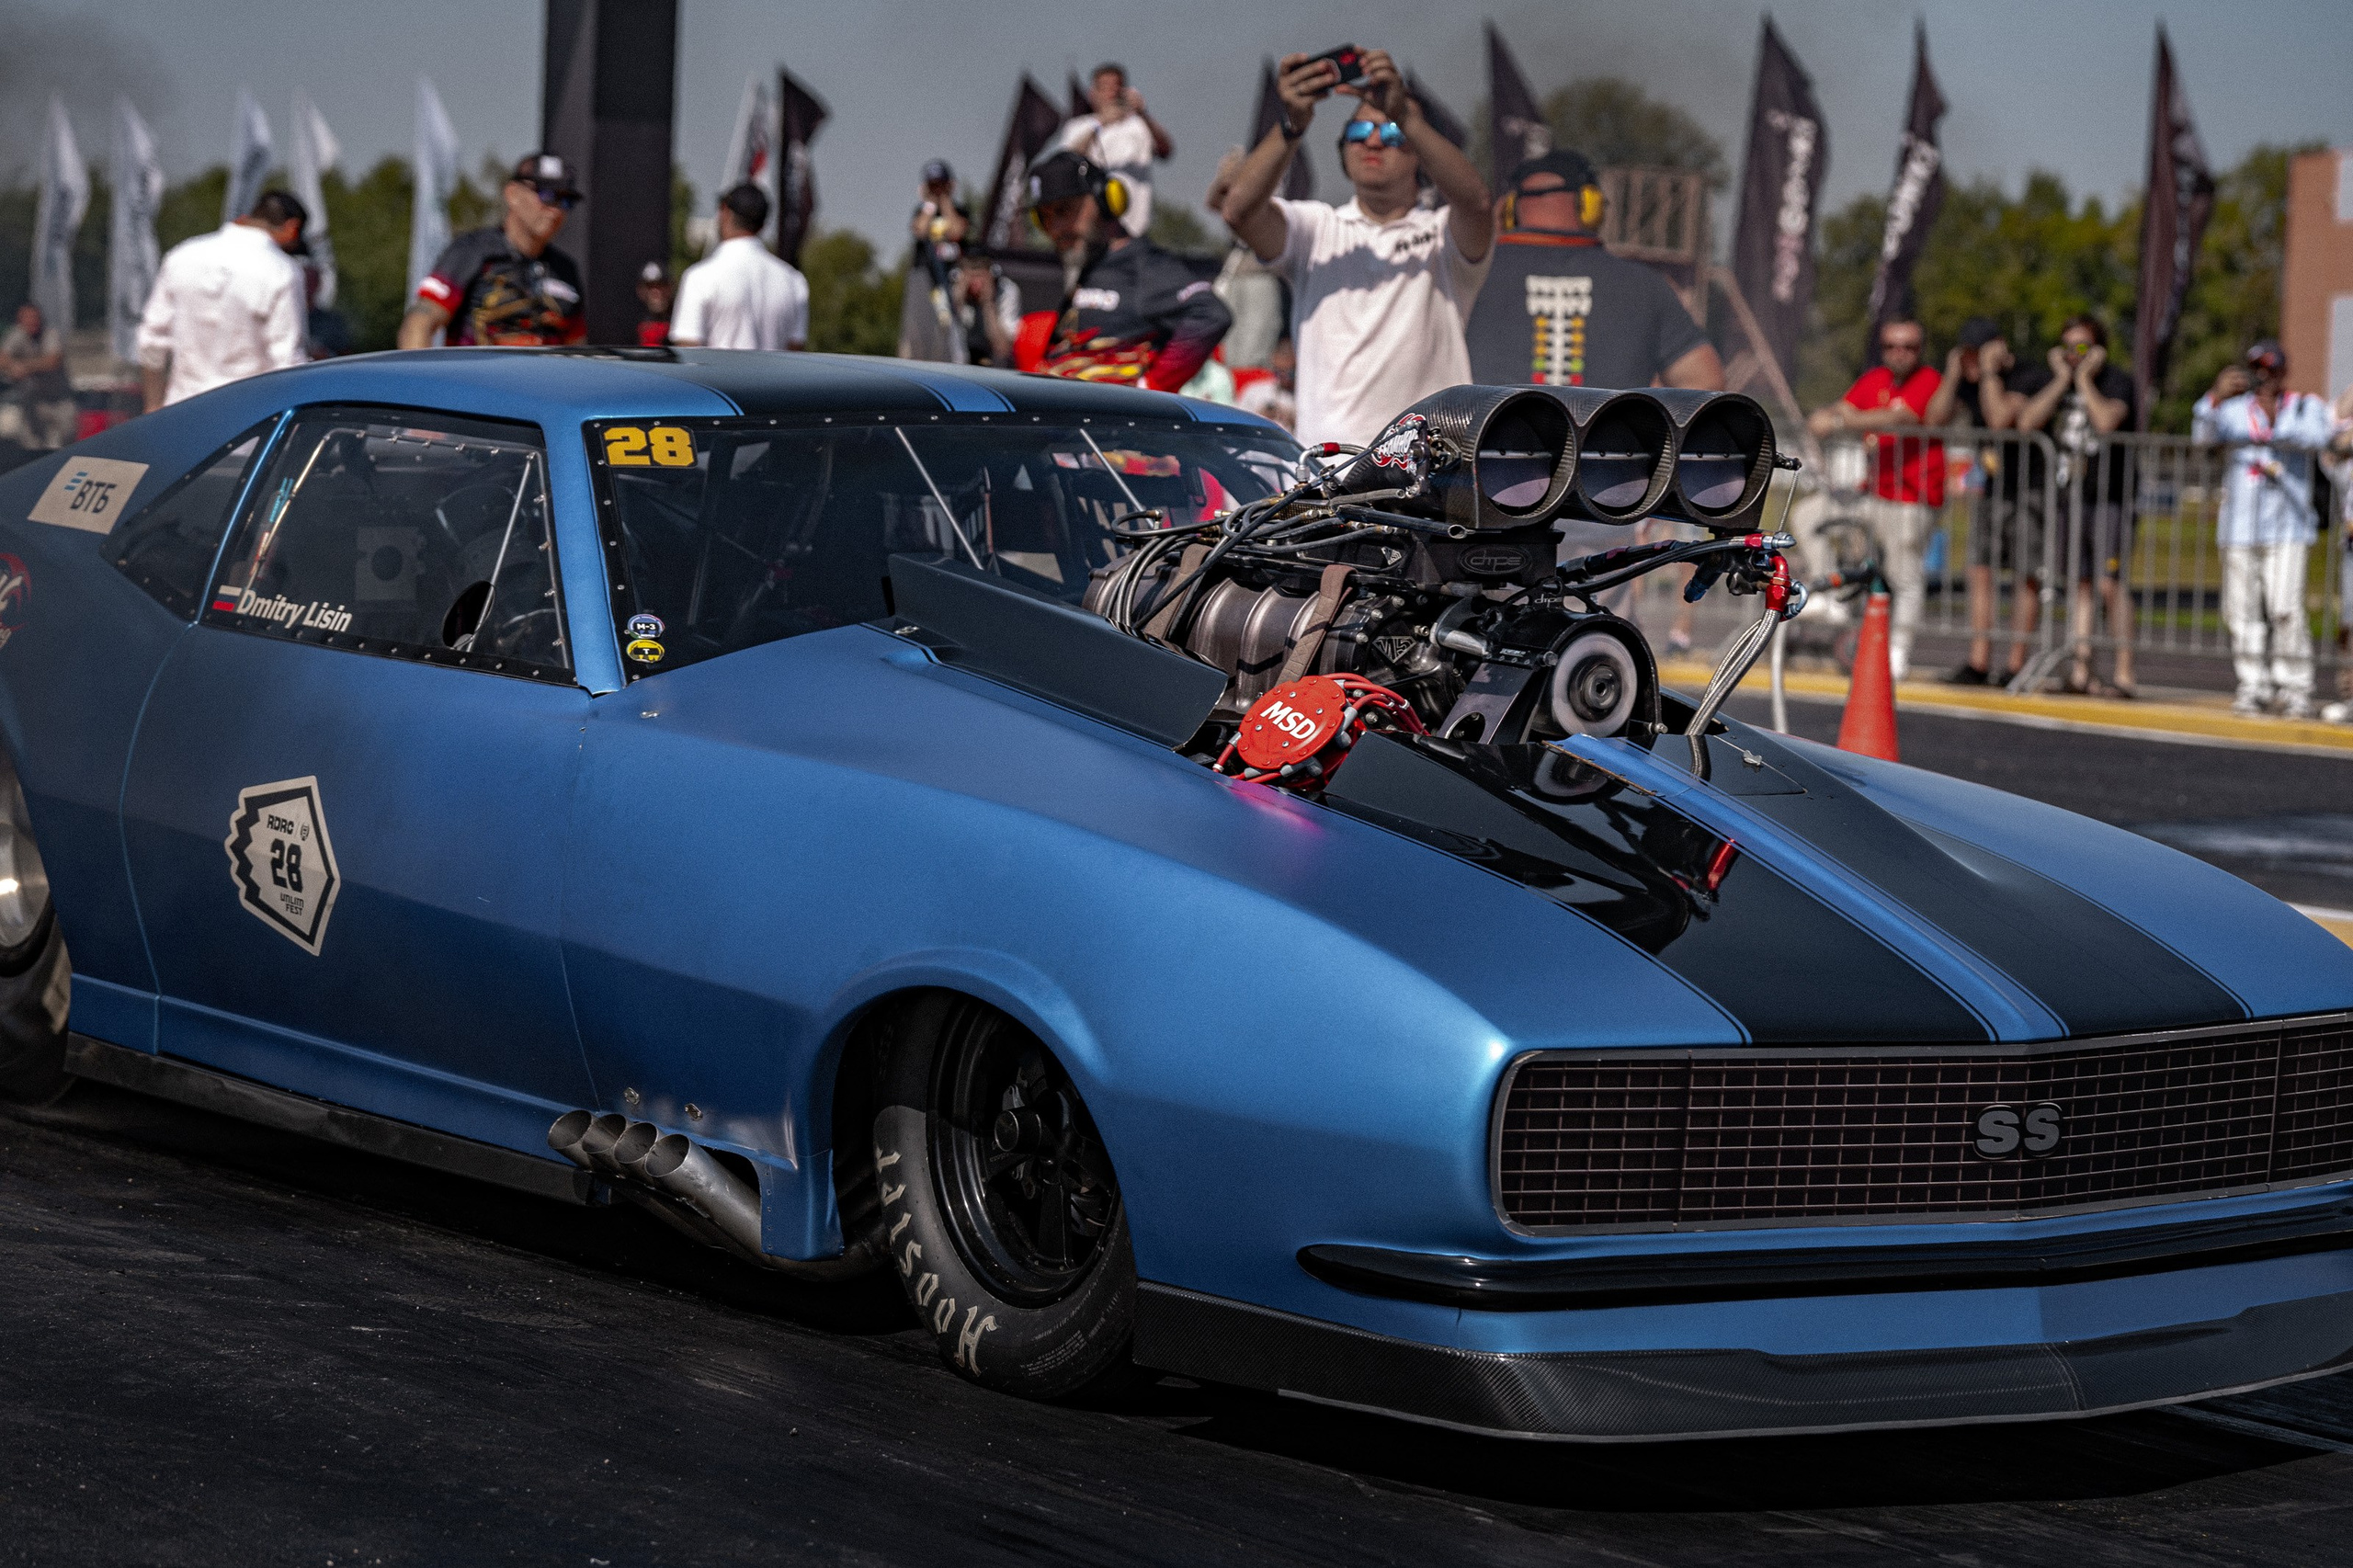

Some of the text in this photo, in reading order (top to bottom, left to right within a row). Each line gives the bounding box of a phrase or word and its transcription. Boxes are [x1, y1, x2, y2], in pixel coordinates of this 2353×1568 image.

[604, 426, 695, 466] 28
[71, 480, 117, 514] ВТБ
[237, 589, 353, 632] Dmitry Lisin
[1260, 700, 1316, 739] MSD
[267, 814, 295, 835] RDRC
[270, 838, 302, 893] 28
[286, 903, 303, 916] FEST
[1975, 1107, 2061, 1155] SS
